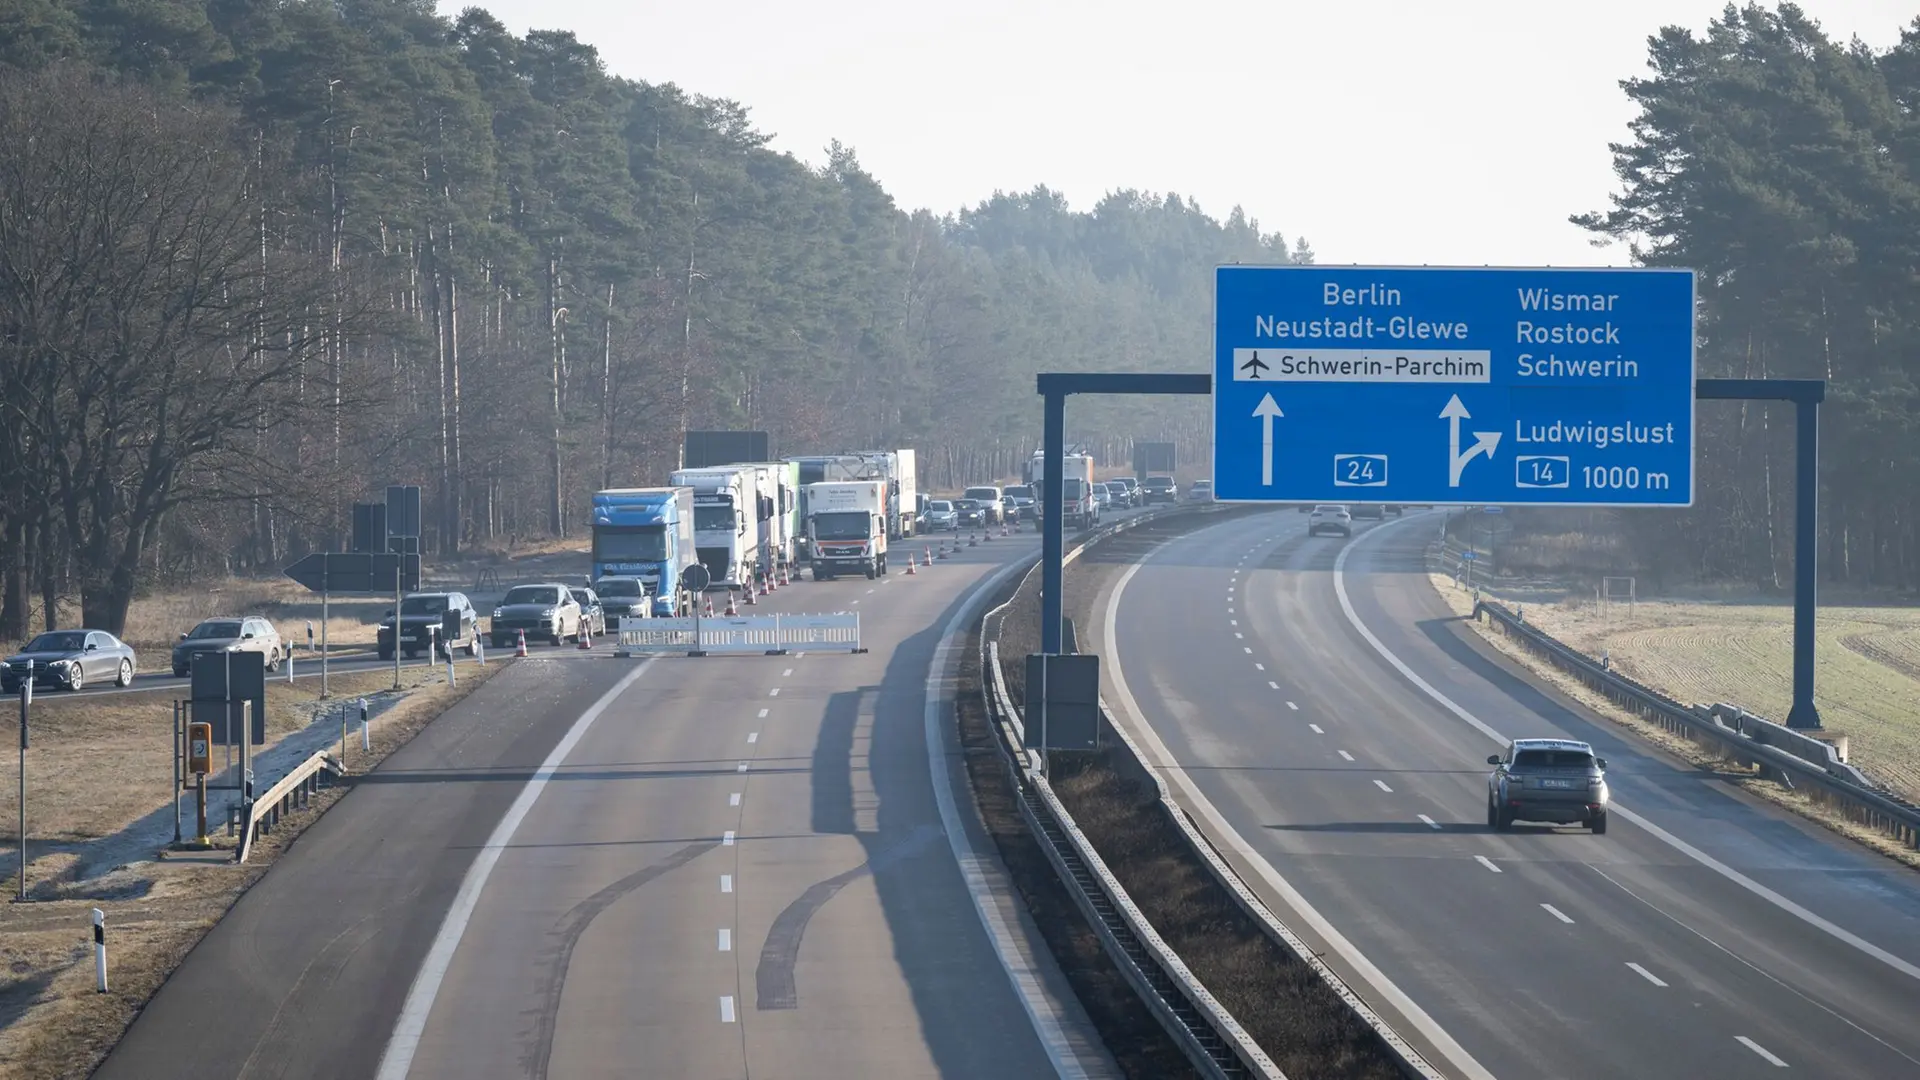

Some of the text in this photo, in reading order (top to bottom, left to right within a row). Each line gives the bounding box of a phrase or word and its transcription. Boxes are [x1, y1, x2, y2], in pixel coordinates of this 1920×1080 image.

[1323, 282, 1401, 306] Berlin
[1518, 288, 1619, 312] Wismar
[1255, 315, 1468, 340] Neustadt-Glewe
[1516, 321, 1620, 345] Rostock
[1281, 355, 1484, 377] Schwerin-Parchim
[1517, 353, 1638, 378] Schwerin
[1516, 420, 1674, 449] Ludwigslust
[1348, 460, 1374, 480] 24
[1532, 462, 1553, 482] 14
[1583, 466, 1669, 489] 1000 m
